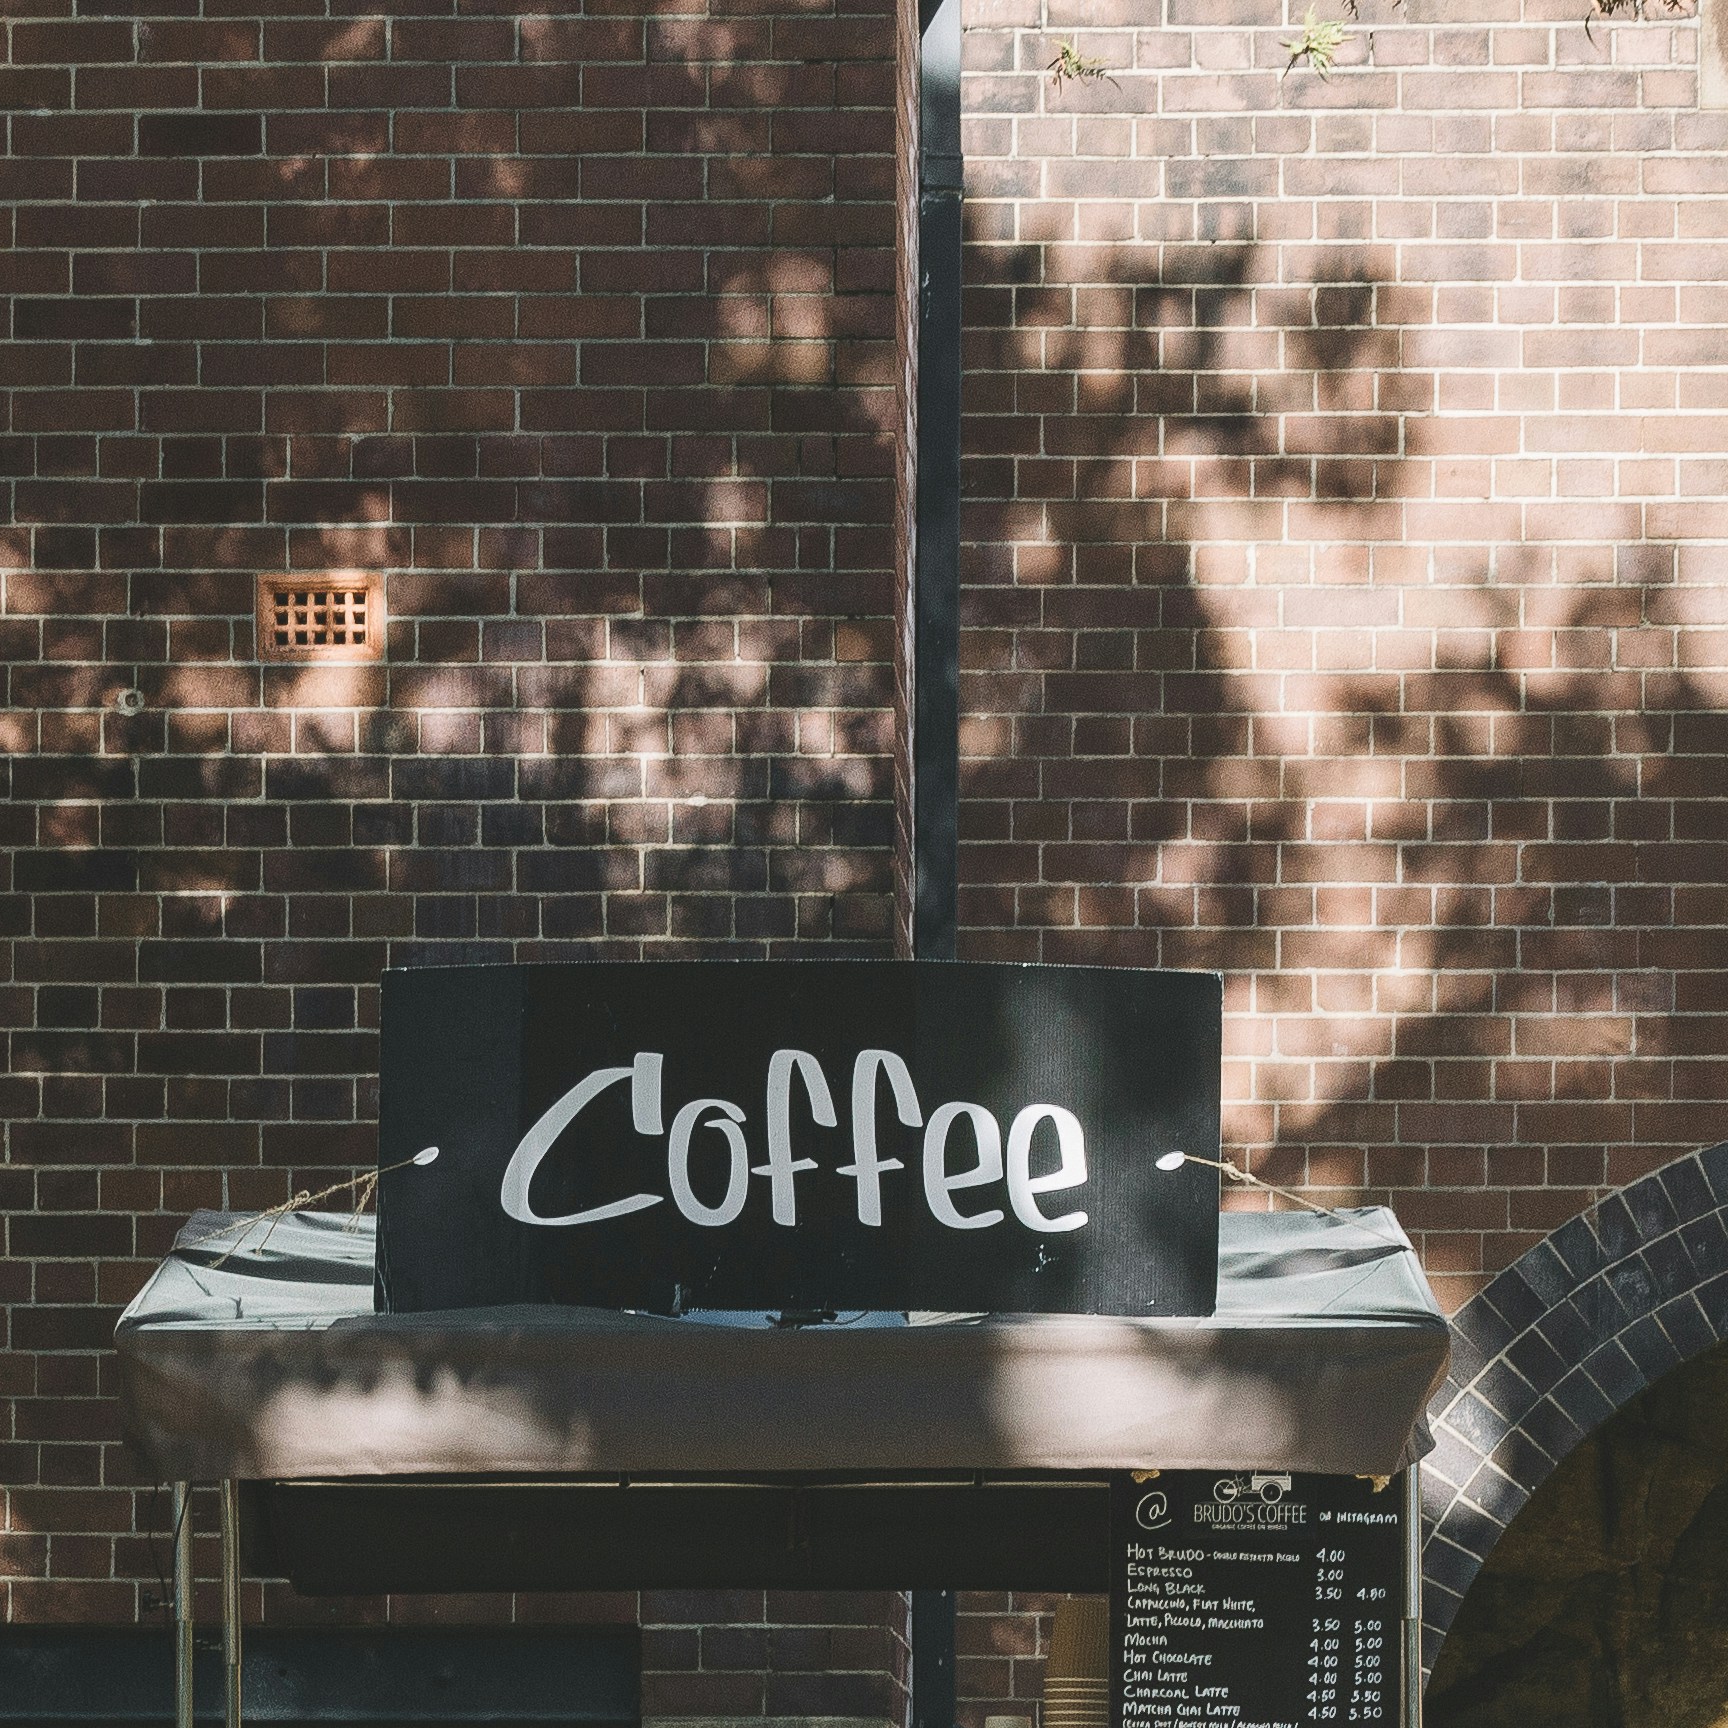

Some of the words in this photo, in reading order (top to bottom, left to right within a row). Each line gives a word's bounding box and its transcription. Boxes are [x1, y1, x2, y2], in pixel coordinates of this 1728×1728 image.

[501, 1049, 1089, 1232] Coffee
[1193, 1504, 1255, 1524] BRUDO'S
[1257, 1504, 1307, 1524] COFFEE
[1127, 1543, 1153, 1560] HOT
[1316, 1547, 1346, 1563] 4.00
[1127, 1563, 1193, 1579] ESPRESSO
[1317, 1568, 1344, 1582] 3.00
[1127, 1578, 1160, 1595] LONG
[1165, 1581, 1206, 1596] BLACK
[1315, 1586, 1342, 1600] 3.50
[1193, 1597, 1219, 1611] FLAT
[1312, 1618, 1341, 1633] 3.50
[1354, 1620, 1382, 1634] 5.00
[1124, 1632, 1168, 1647] MOCHA
[1309, 1638, 1340, 1652] 4.00
[1355, 1637, 1383, 1653] 5.00
[1123, 1649, 1147, 1665] HOT
[1152, 1650, 1213, 1666] CHOCOLATE
[1307, 1655, 1339, 1668] 4.00
[1354, 1654, 1381, 1668] 5.00
[1123, 1668, 1153, 1683] CHAI
[1157, 1668, 1188, 1683] LATTE
[1308, 1671, 1337, 1685] 4.00
[1354, 1670, 1383, 1685] 5.00
[1123, 1685, 1190, 1699] CHARCOAL
[1195, 1685, 1229, 1698] LATTE
[1306, 1688, 1336, 1703] 4.50
[1350, 1689, 1381, 1703] 5.50
[1122, 1700, 1172, 1715] MATCHA
[1176, 1703, 1202, 1716] CHAI
[1206, 1702, 1241, 1717] LATTE
[1307, 1706, 1337, 1720] 4.50
[1348, 1706, 1383, 1720] 5.50
